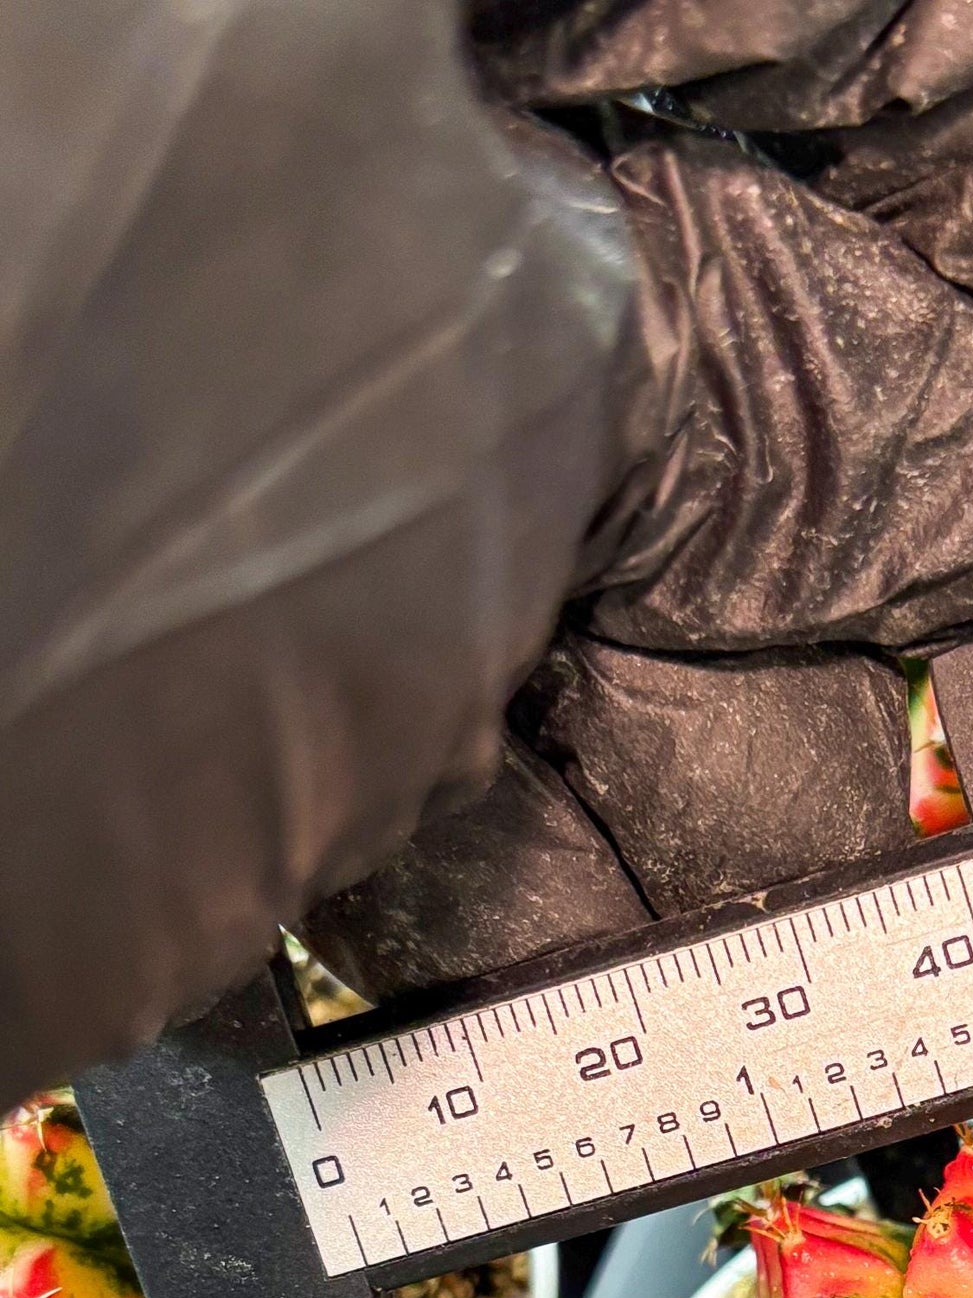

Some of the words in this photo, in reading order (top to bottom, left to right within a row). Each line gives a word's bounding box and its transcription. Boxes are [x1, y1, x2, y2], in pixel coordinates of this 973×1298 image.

[312, 1155, 345, 1189] 0
[427, 1085, 479, 1125] 10
[574, 1035, 644, 1082] 20
[741, 985, 811, 1031] 30
[379, 1197, 391, 1216] 1
[410, 1186, 434, 1207] 2
[451, 1173, 474, 1194] 3
[495, 1162, 514, 1182] 4
[533, 1149, 554, 1171] 5
[574, 1137, 596, 1159] 6
[618, 1124, 637, 1145] 7
[657, 1112, 681, 1134] 8
[699, 1100, 722, 1123] 9
[736, 1065, 755, 1095] 1
[792, 1074, 804, 1094] 1
[824, 1063, 846, 1084] 2
[866, 1050, 888, 1071] 3
[911, 1037, 929, 1058] 4
[950, 1024, 971, 1045] 5
